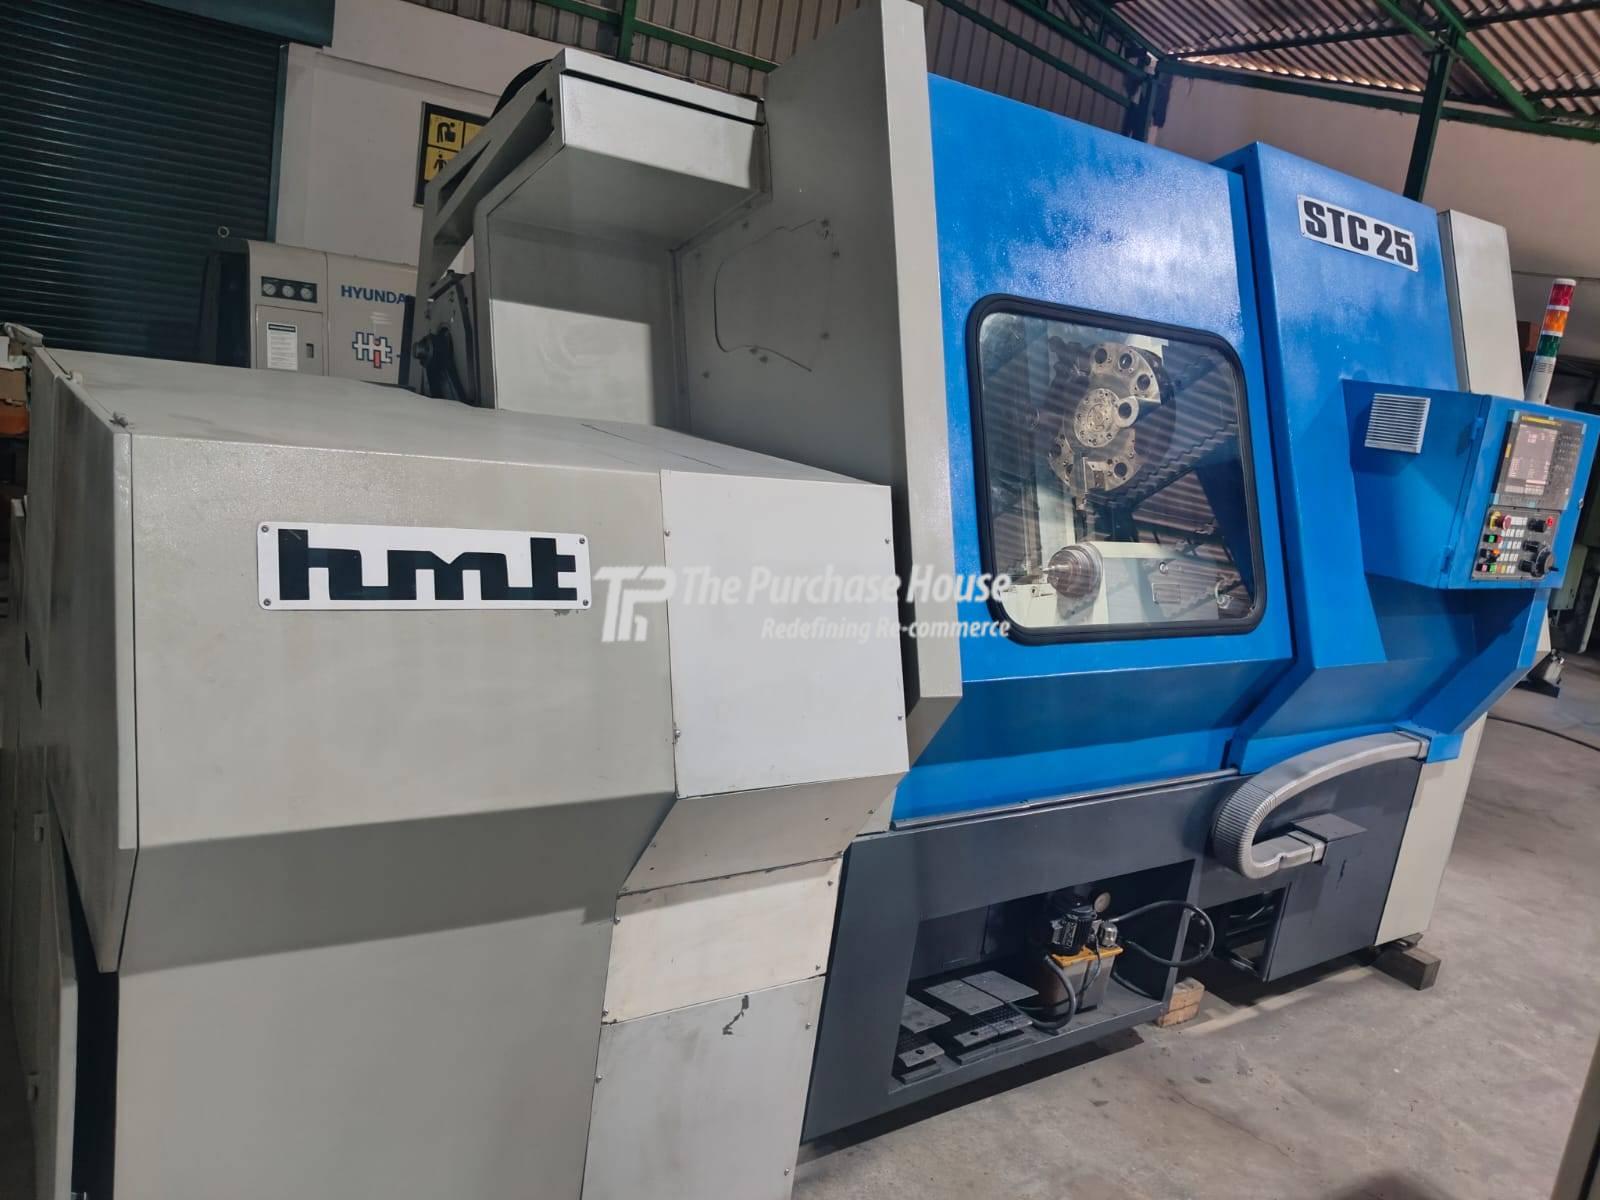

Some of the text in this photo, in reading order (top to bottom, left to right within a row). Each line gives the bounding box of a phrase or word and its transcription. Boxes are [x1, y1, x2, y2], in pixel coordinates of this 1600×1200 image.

[1303, 200, 1414, 266] STC 25
[341, 284, 412, 305] HYUNDA
[277, 528, 578, 601] hmt
